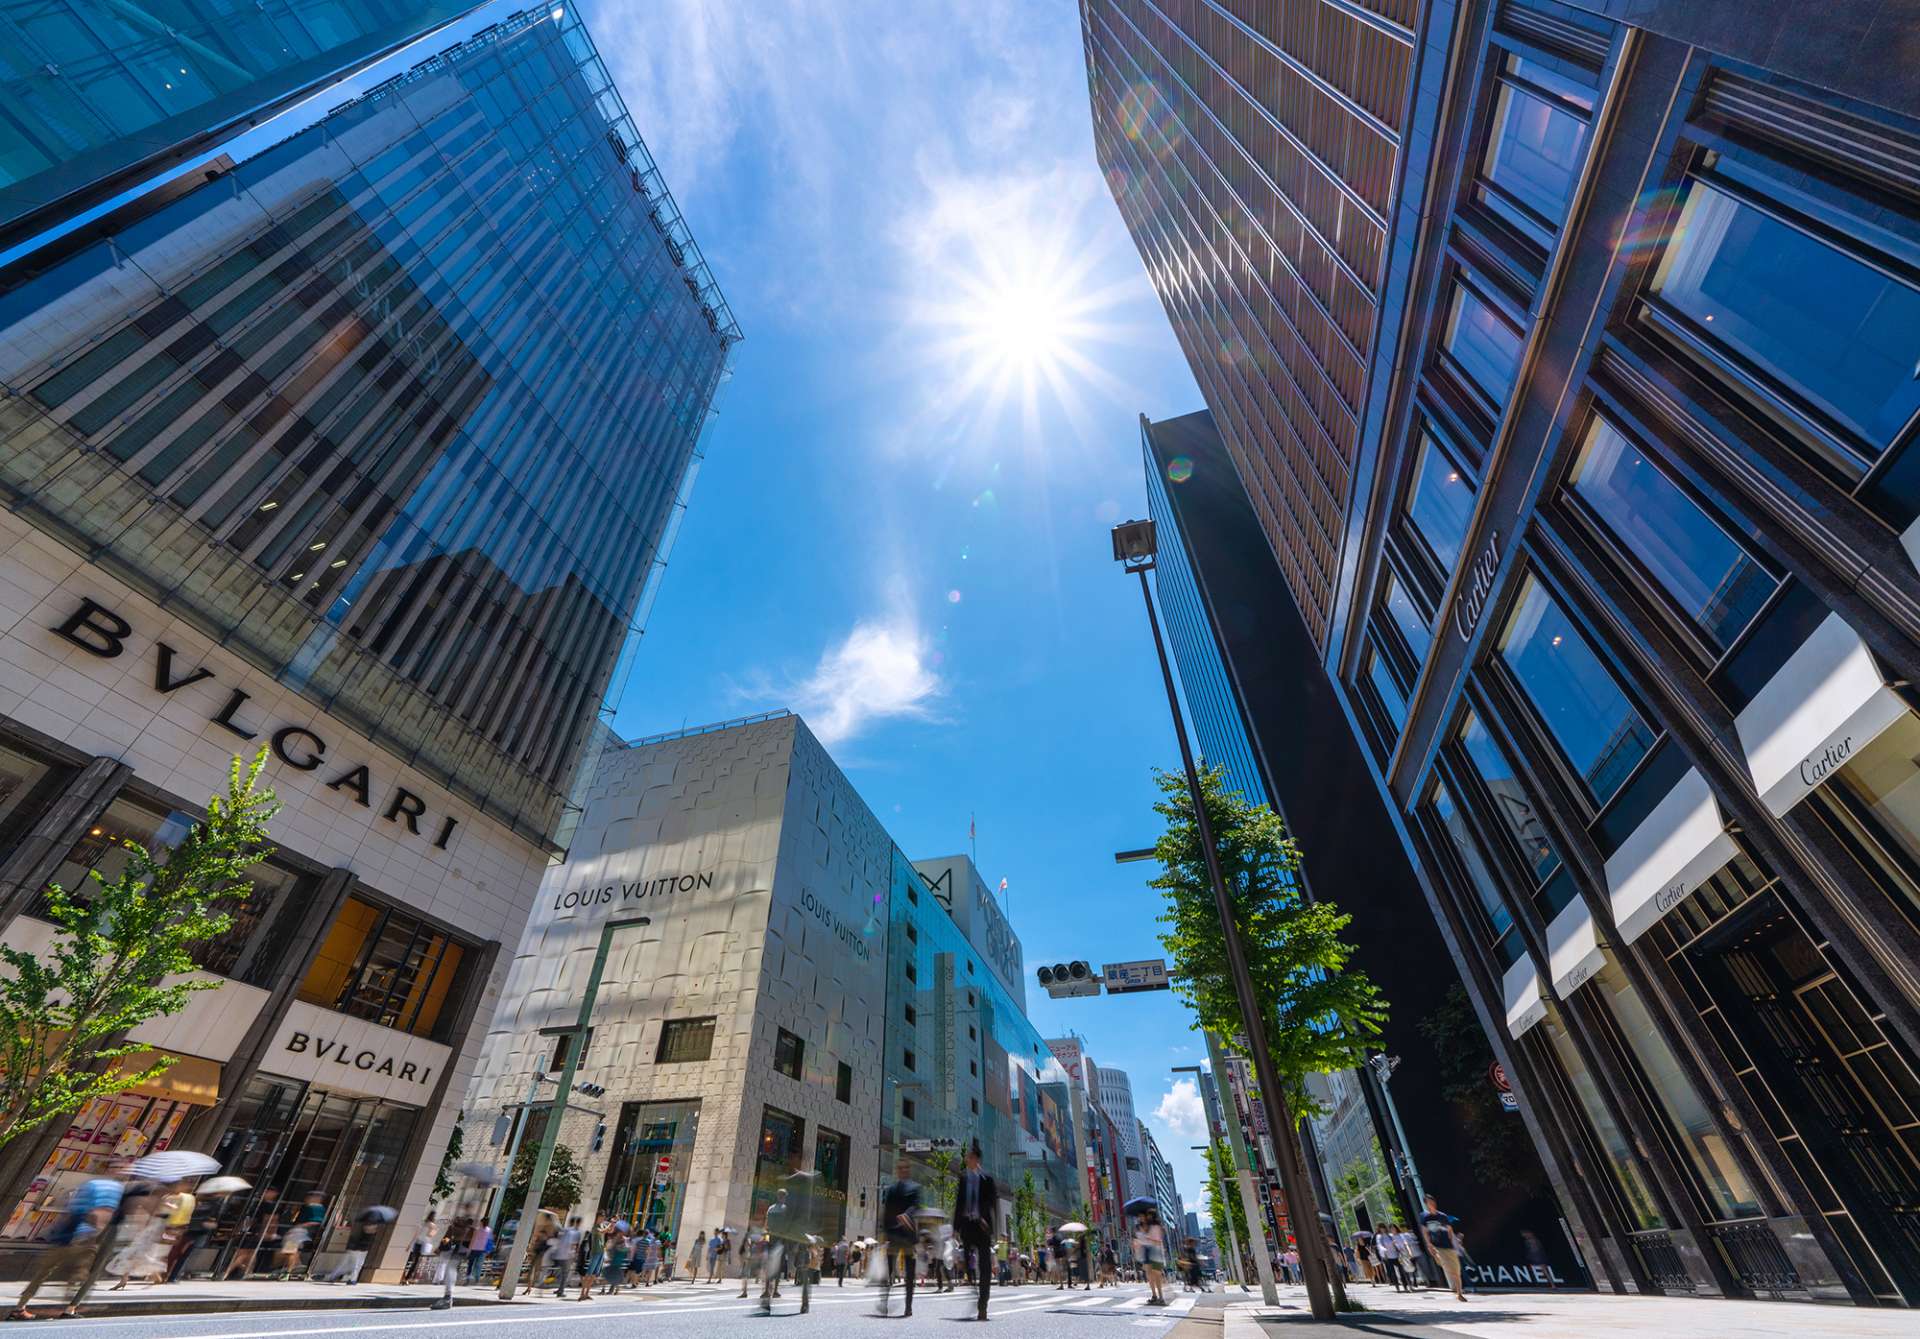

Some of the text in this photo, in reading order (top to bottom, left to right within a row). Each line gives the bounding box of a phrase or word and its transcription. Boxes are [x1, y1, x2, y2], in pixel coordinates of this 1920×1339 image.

[1454, 530, 1500, 643] Cartier
[49, 597, 458, 850] BVLGARI
[1800, 736, 1851, 786] Cartier
[553, 872, 714, 911] LOUIS VUITTON
[1655, 882, 1685, 912] Cartier
[801, 888, 870, 961] LOUIS VUITTON
[285, 1031, 433, 1085] BVLGARI
[1464, 1265, 1564, 1283] CHANEL
